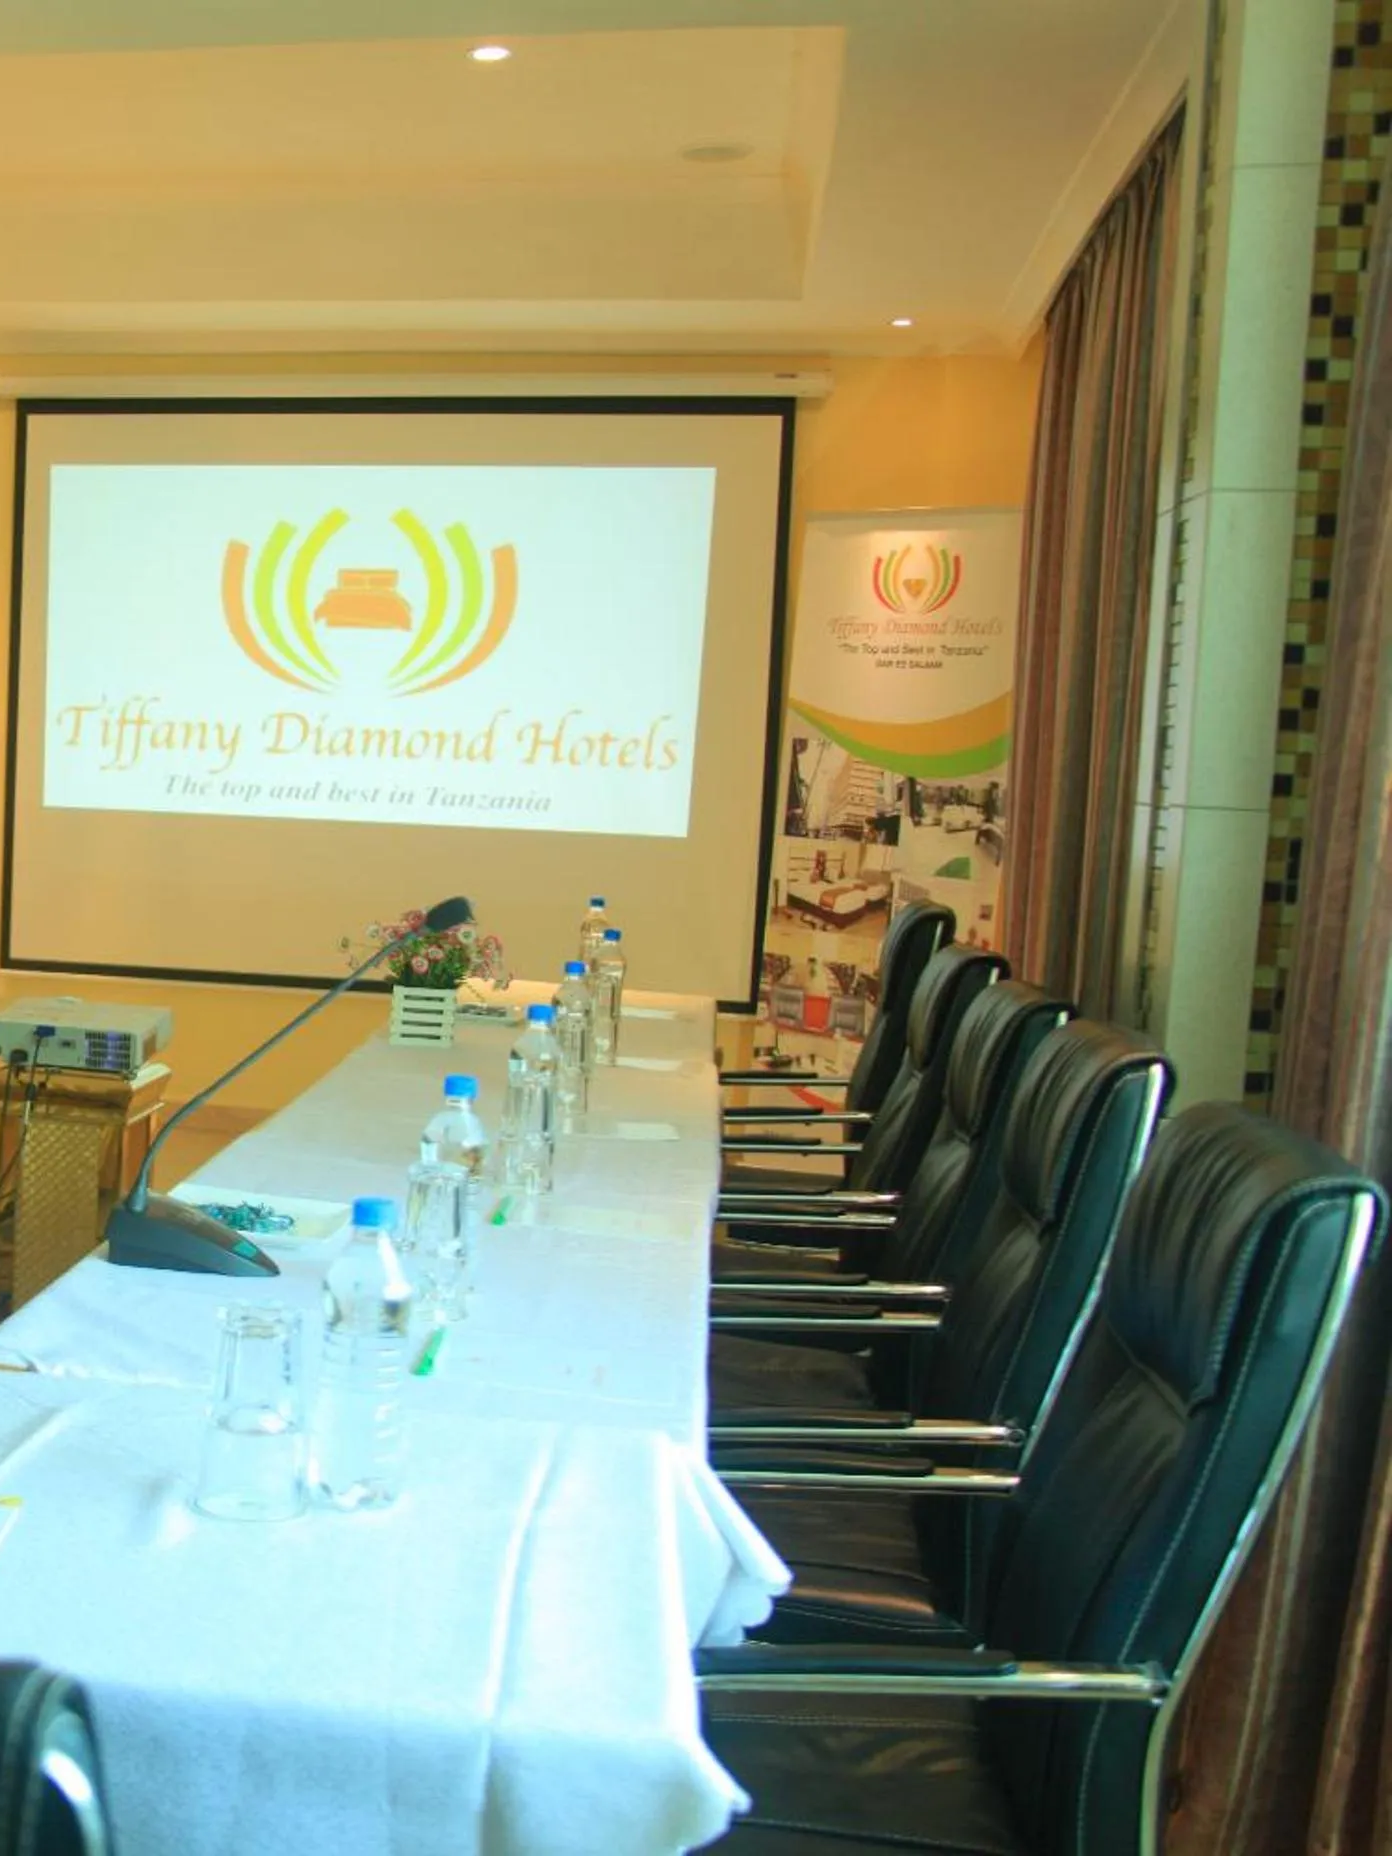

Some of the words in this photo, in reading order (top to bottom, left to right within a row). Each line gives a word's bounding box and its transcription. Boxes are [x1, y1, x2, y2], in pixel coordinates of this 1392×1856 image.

[55, 693, 242, 775] Tiffany
[261, 709, 512, 764] Diamond
[515, 709, 680, 772] Hotels
[165, 774, 210, 796] The
[220, 780, 262, 803] top
[268, 781, 322, 801] and
[327, 782, 380, 804] best
[388, 784, 415, 805] in
[426, 786, 553, 812] Tanzania
